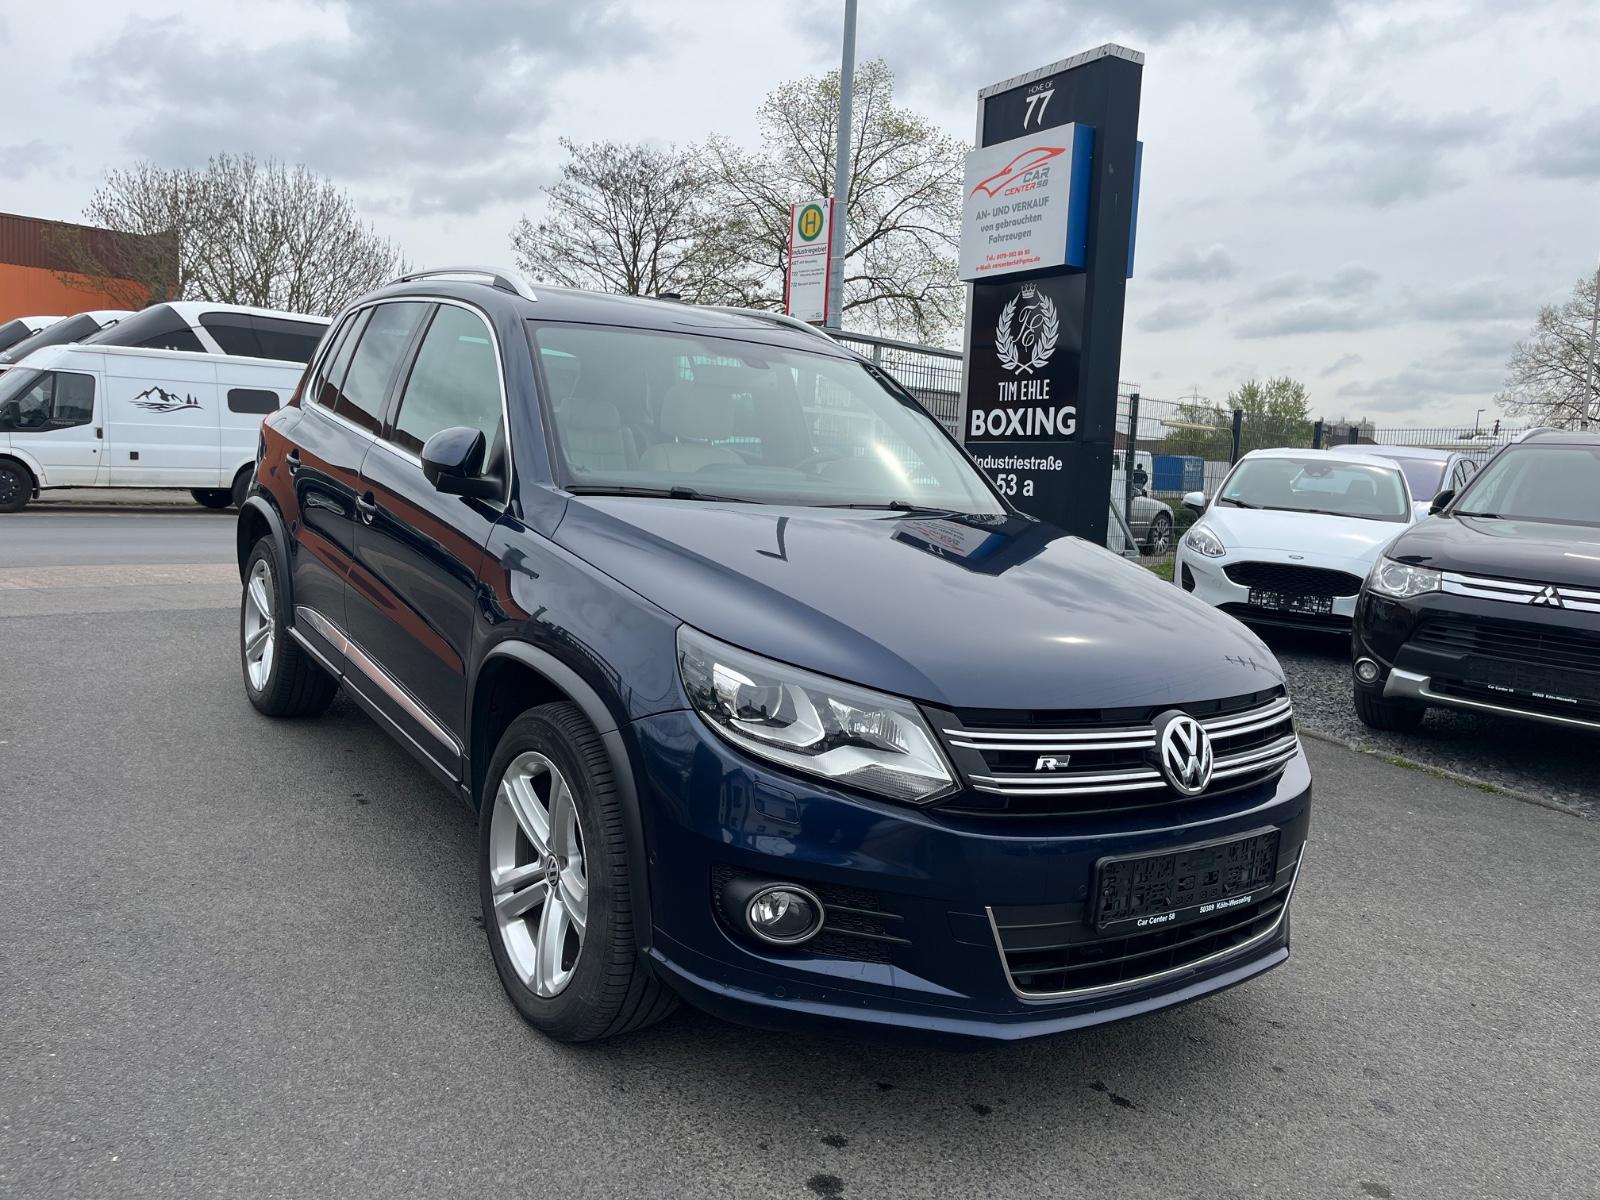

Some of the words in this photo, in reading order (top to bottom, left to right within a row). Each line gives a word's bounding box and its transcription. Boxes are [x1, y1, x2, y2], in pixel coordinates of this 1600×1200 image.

[1023, 89, 1055, 130] 77
[1023, 167, 1050, 183] CAR
[975, 211, 992, 222] AN-
[992, 206, 1010, 217] UND
[1012, 196, 1050, 214] VERKAUF
[980, 222, 994, 233] von
[995, 214, 1042, 232] gebrauchten
[988, 230, 1032, 244] Fahrzeugen
[998, 381, 1017, 401] TIM
[1021, 379, 1050, 400] EHLE
[971, 406, 1076, 436] BOXING
[996, 473, 1017, 495] 53
[1023, 480, 1034, 497] a
[1035, 758, 1056, 771] R
[1137, 918, 1148, 927] Car
[1149, 915, 1169, 925] Center
